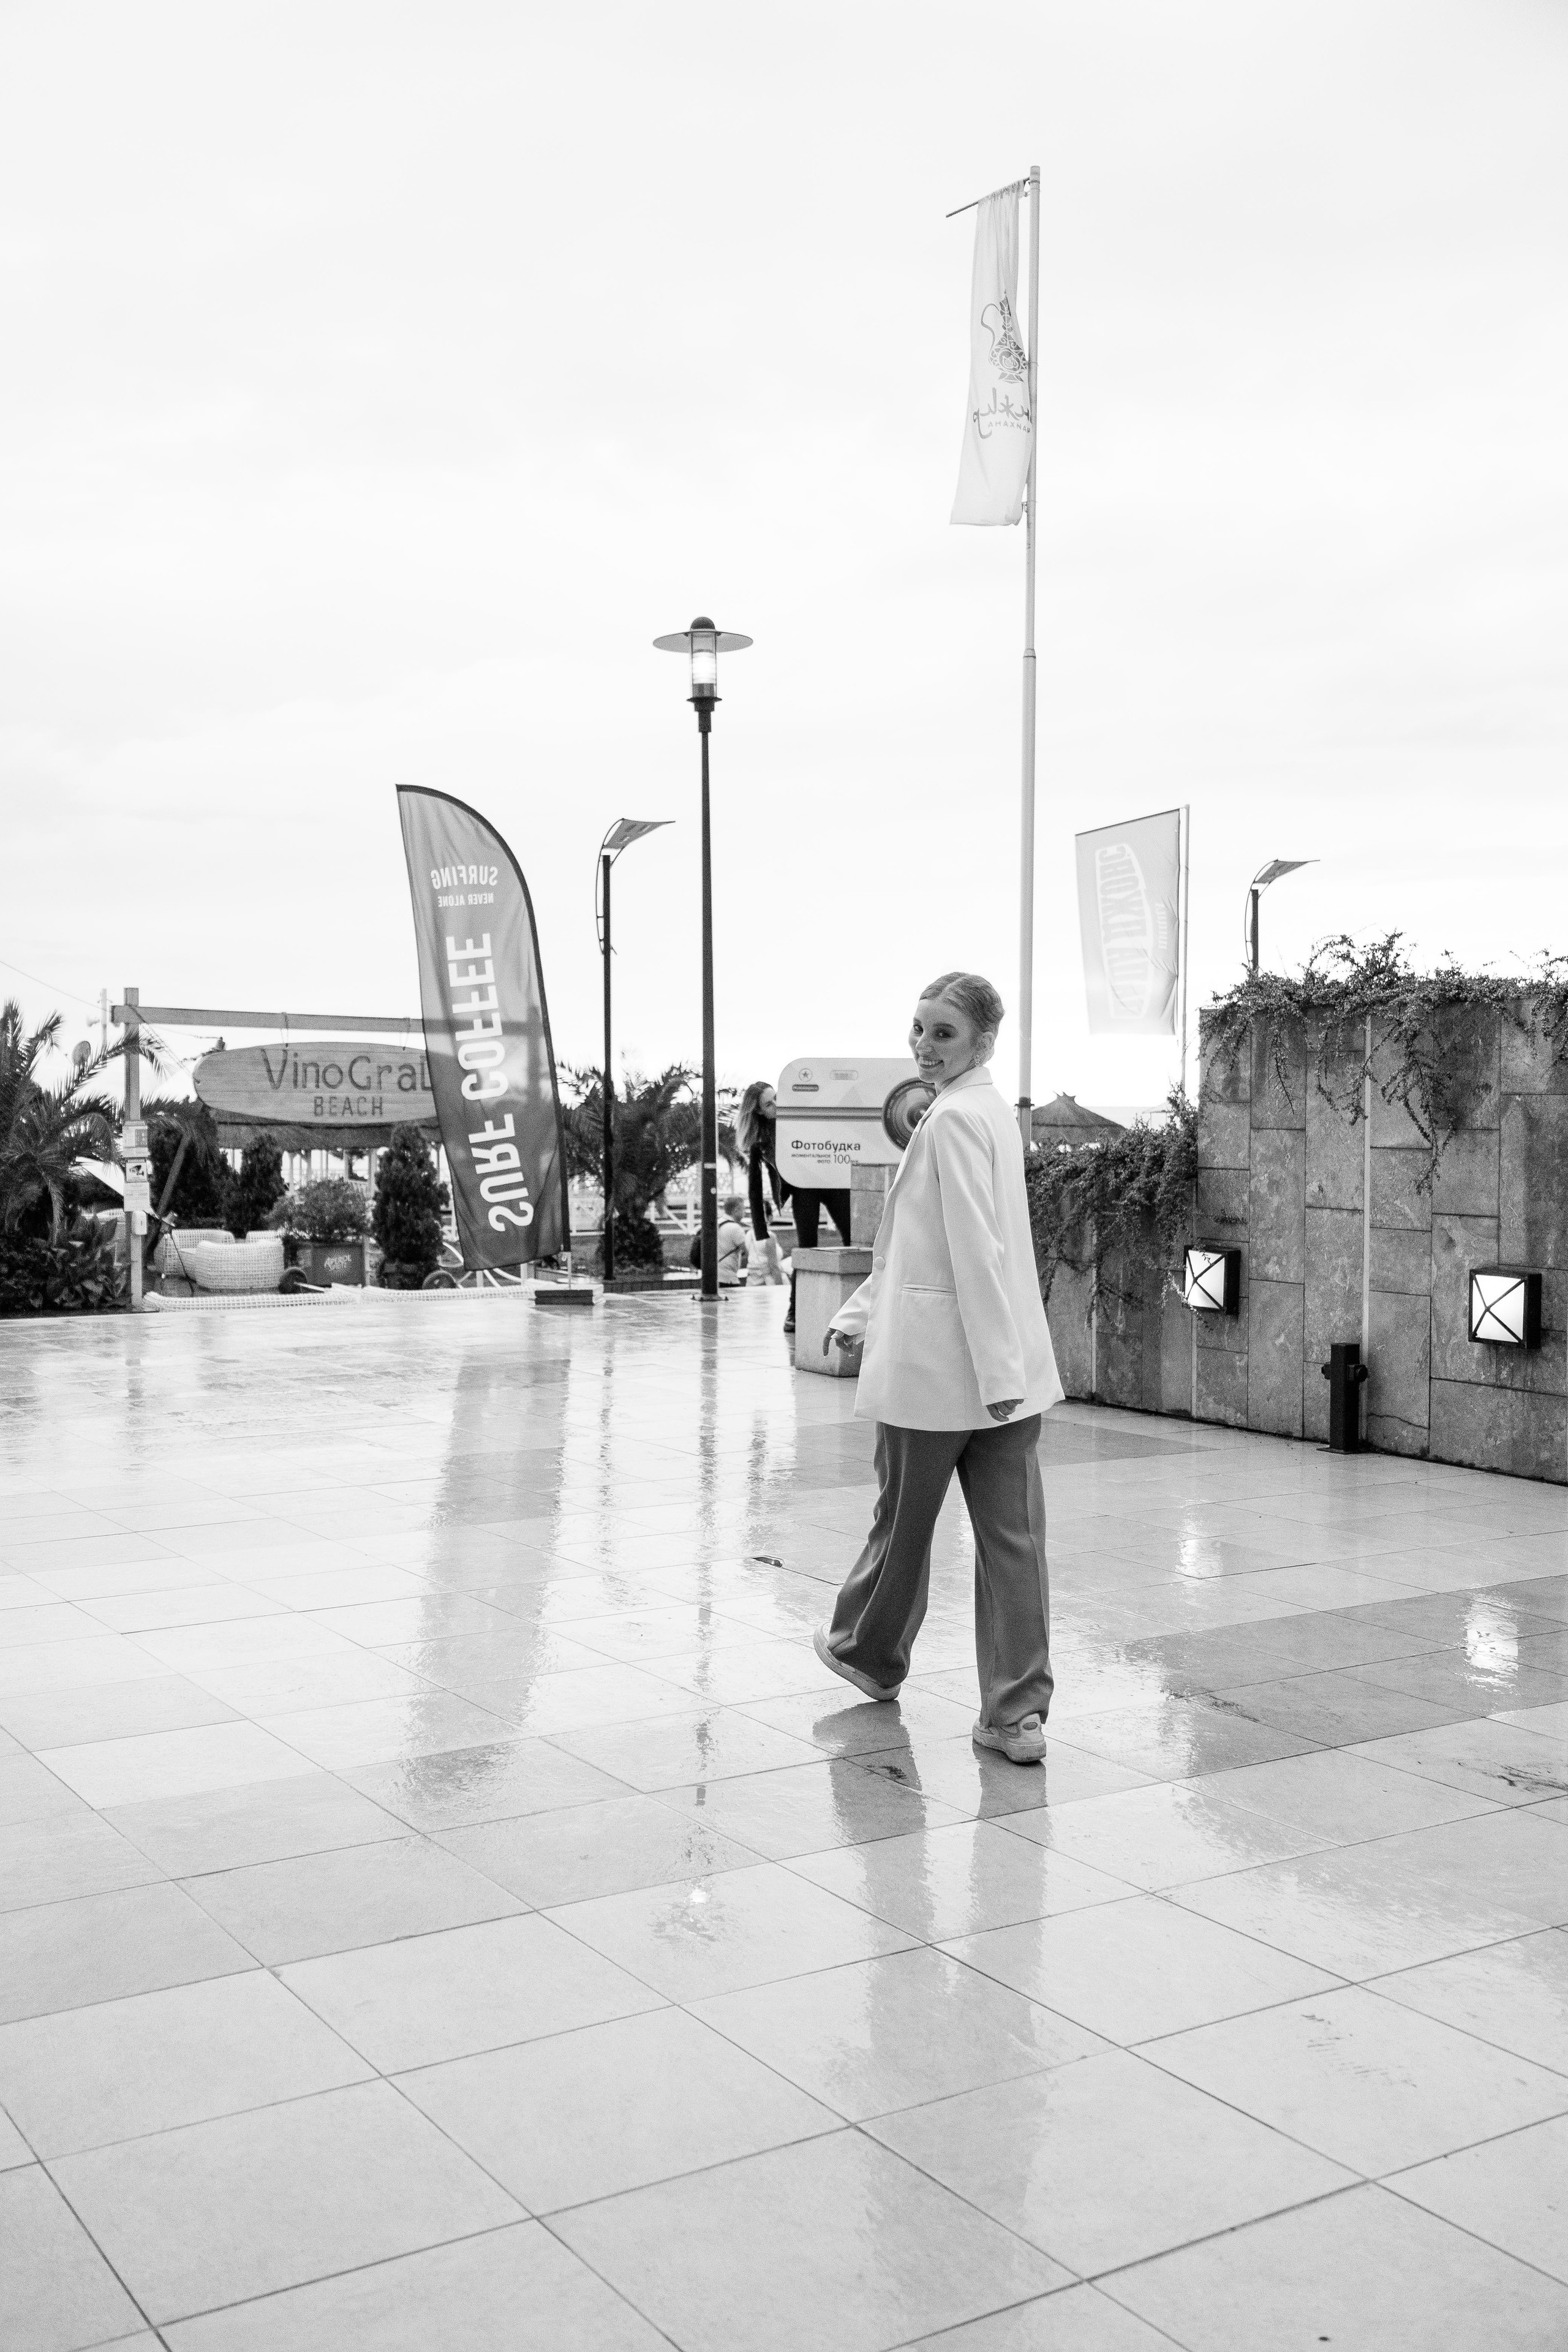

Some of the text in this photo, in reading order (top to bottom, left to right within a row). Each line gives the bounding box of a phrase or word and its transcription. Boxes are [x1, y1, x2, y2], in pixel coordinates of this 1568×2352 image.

[314, 1096, 383, 1117] BEACH
[791, 1140, 861, 1153] Фотобудка
[833, 1154, 850, 1164] 100
